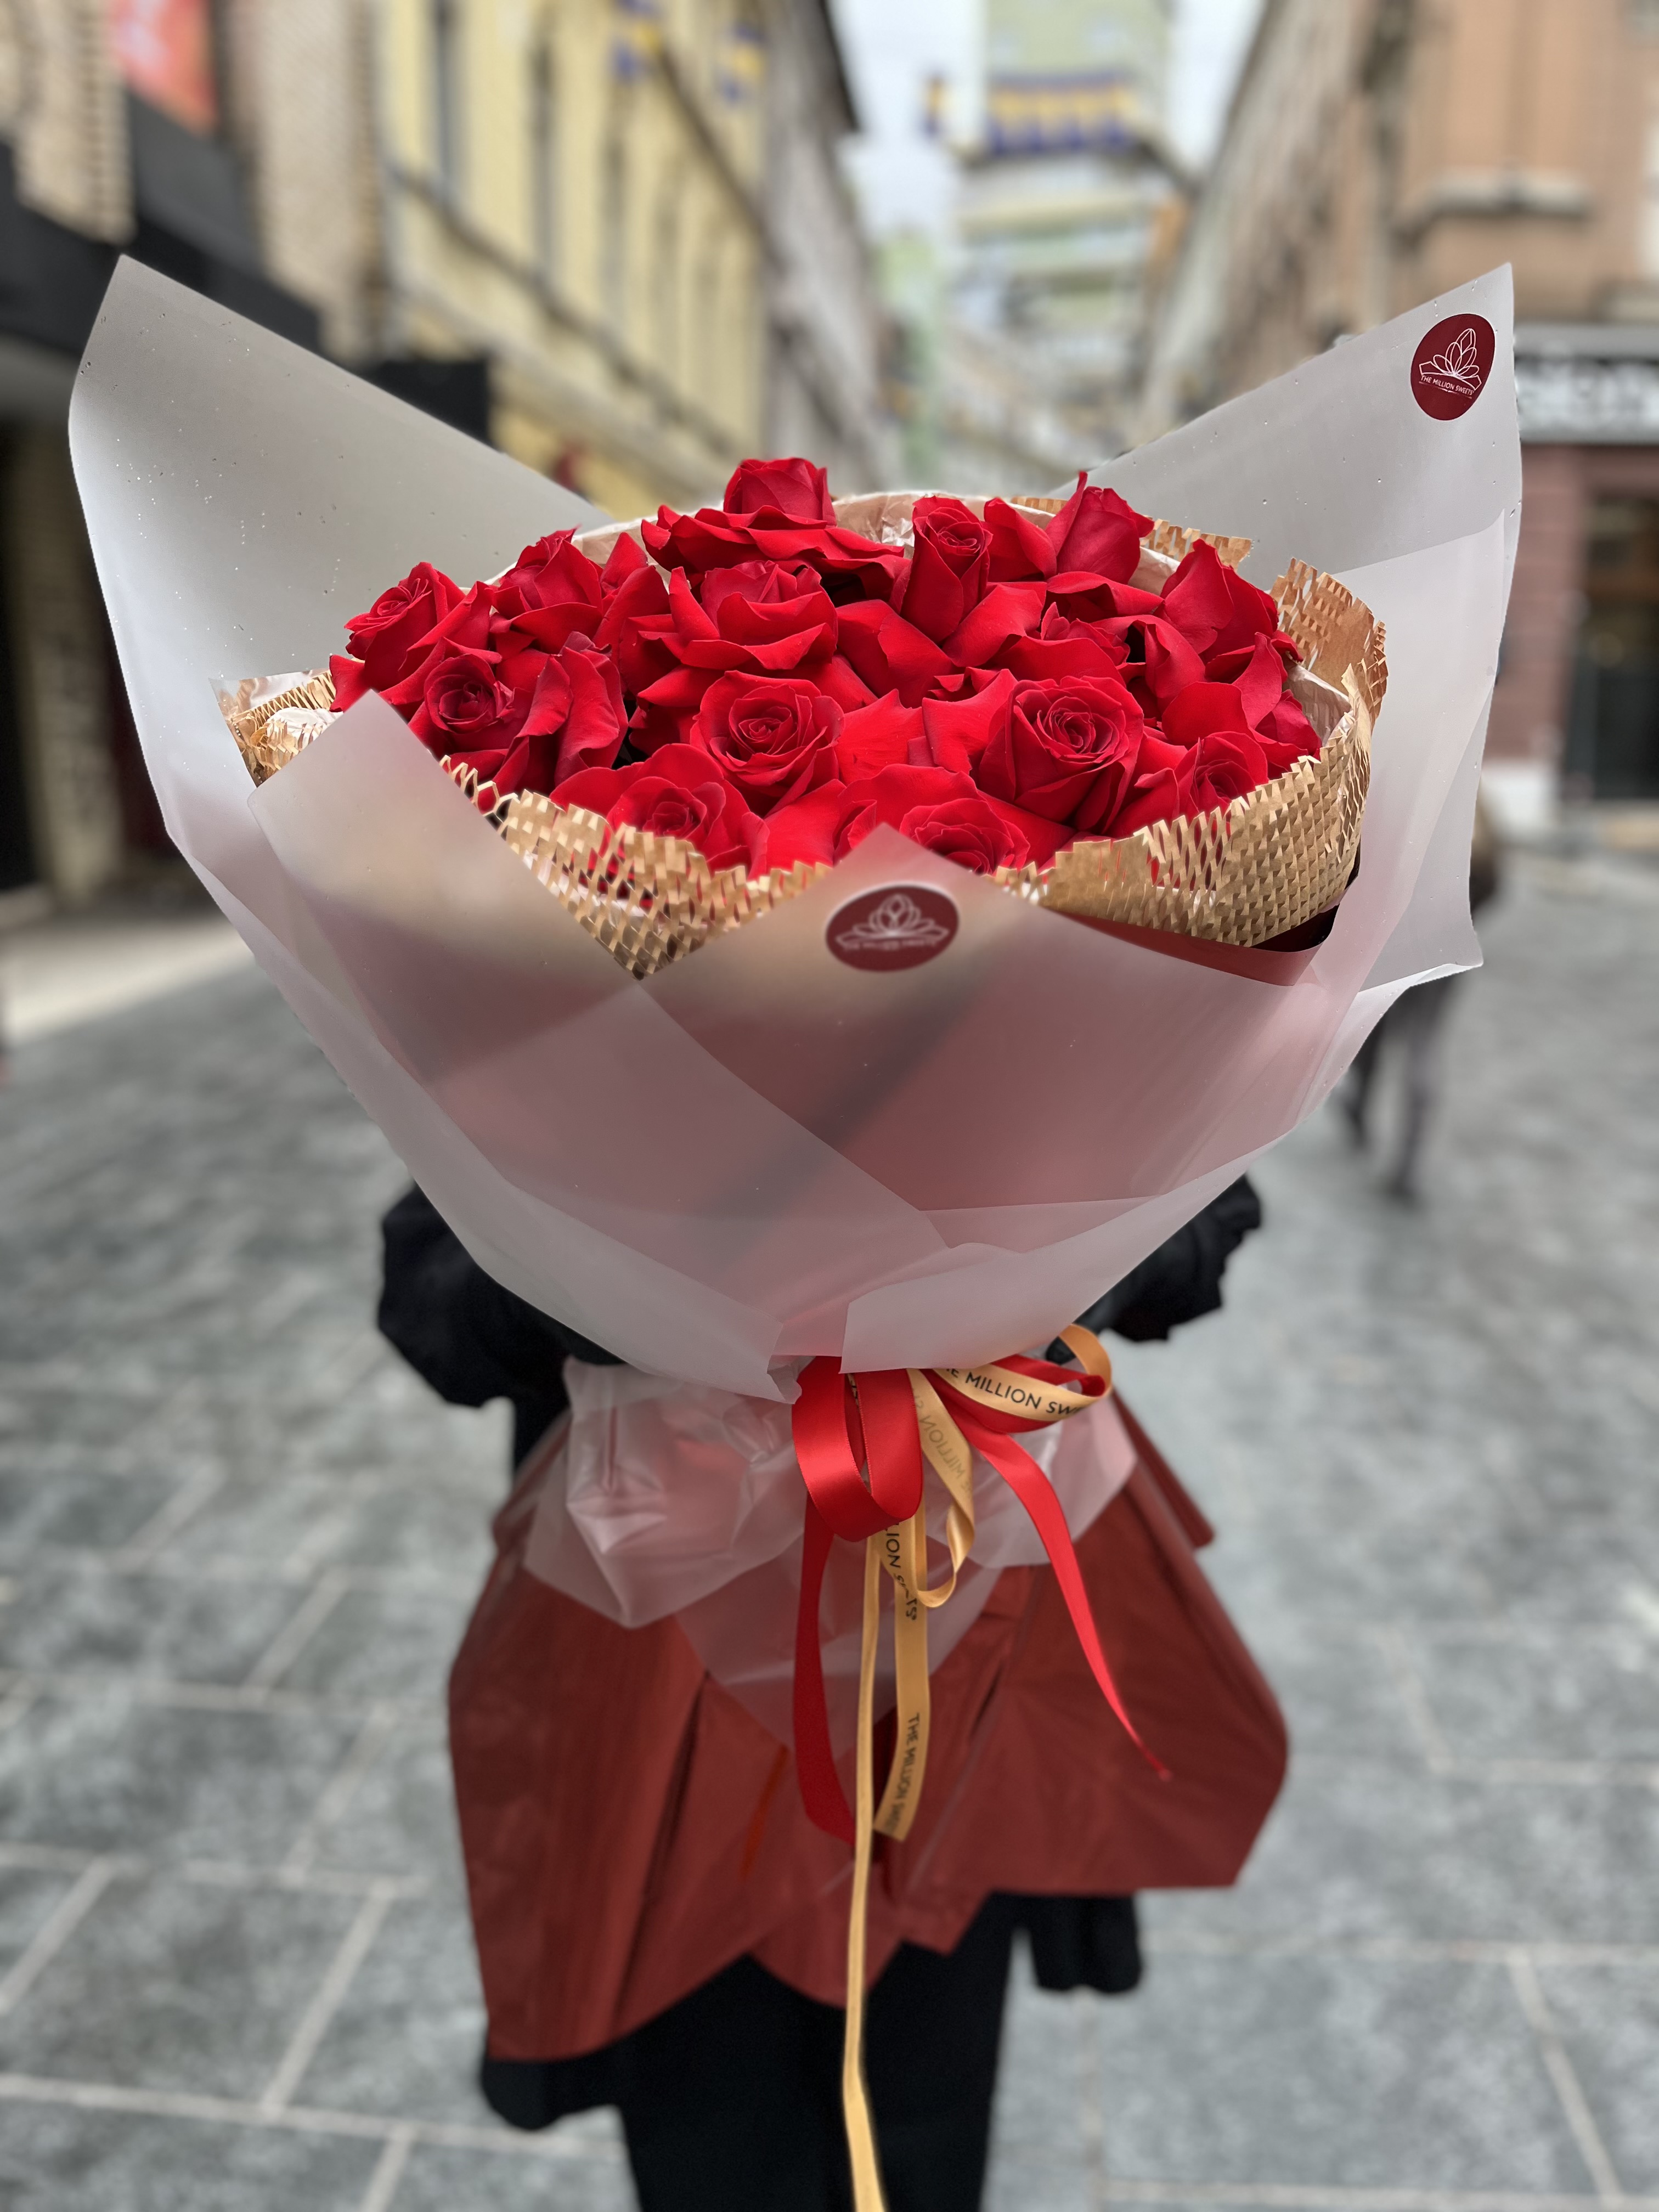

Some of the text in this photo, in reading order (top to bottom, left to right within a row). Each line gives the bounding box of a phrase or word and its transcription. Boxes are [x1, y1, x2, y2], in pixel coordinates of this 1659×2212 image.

[1432, 379, 1455, 390] MILLION
[966, 1372, 1042, 1409] MILLION
[907, 1712, 919, 1745] THE
